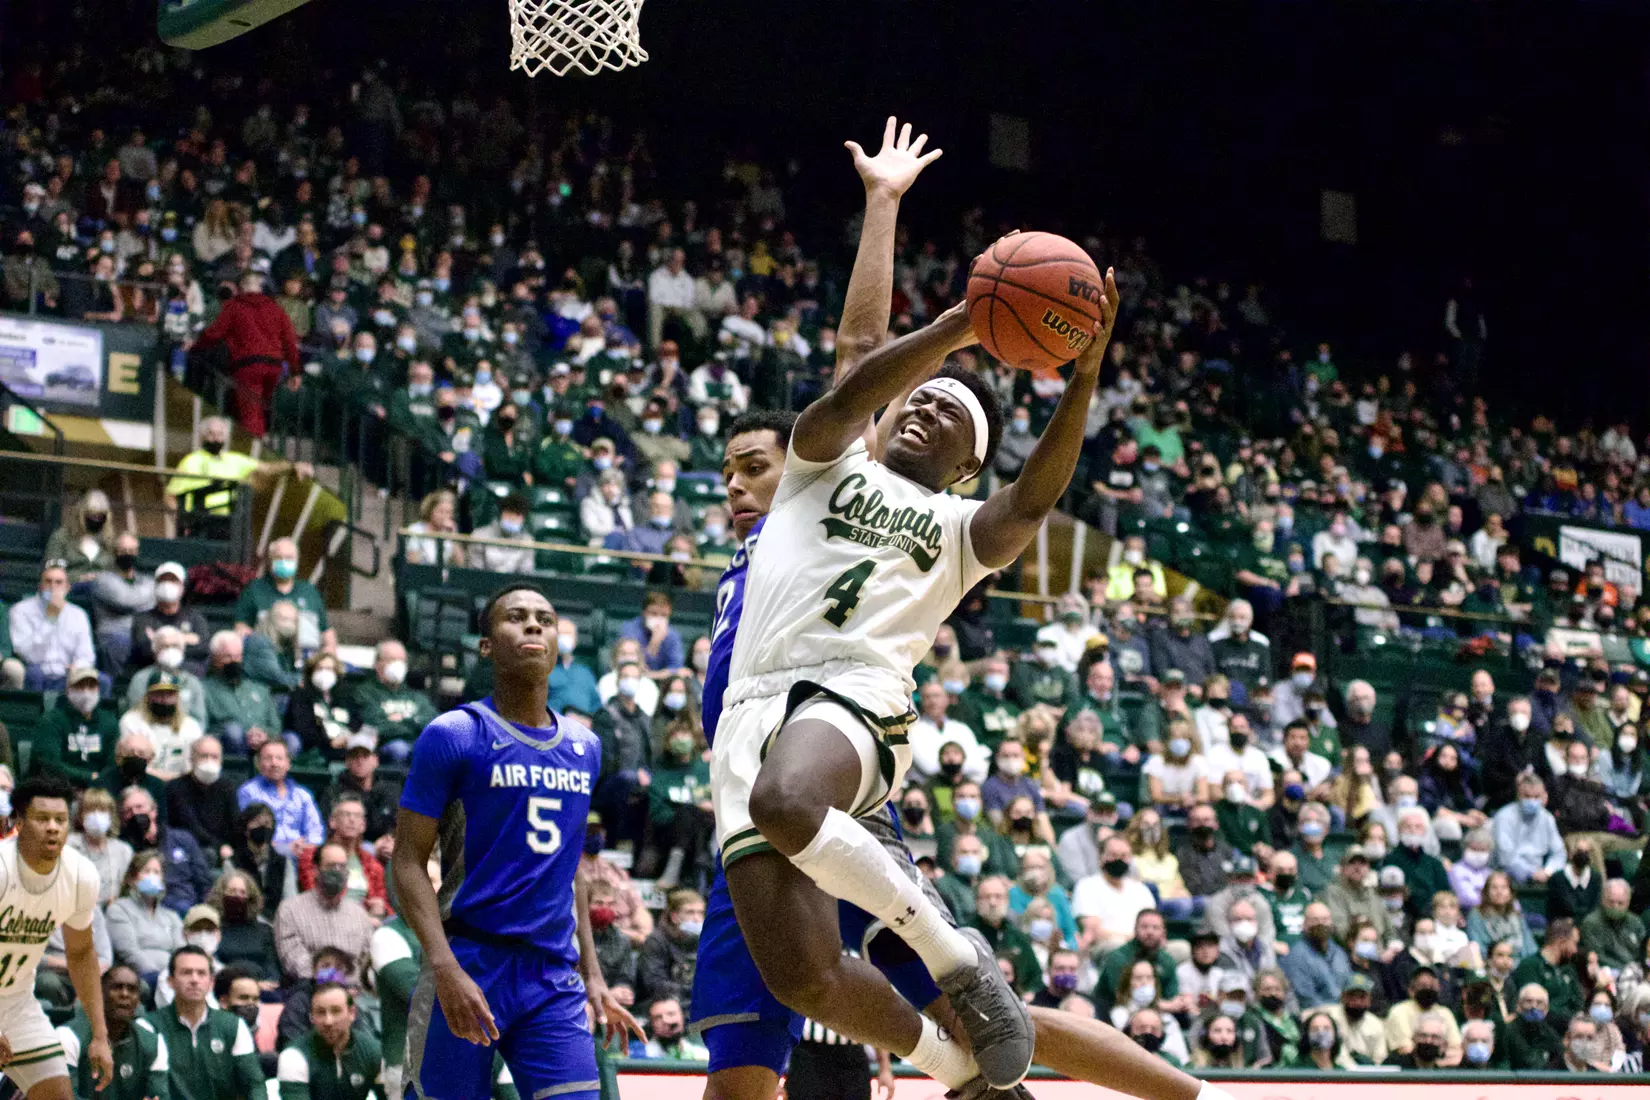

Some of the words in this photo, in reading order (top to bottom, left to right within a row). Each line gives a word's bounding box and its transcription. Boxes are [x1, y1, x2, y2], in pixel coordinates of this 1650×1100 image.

[1068, 276, 1101, 305] CAA
[108, 352, 142, 394] E
[829, 473, 942, 550] Colorado
[849, 527, 887, 548] STATE
[889, 534, 918, 554] UNIV
[821, 558, 879, 630] 4
[490, 764, 529, 787] AIR
[530, 765, 591, 796] FORCE
[526, 796, 562, 855] 5
